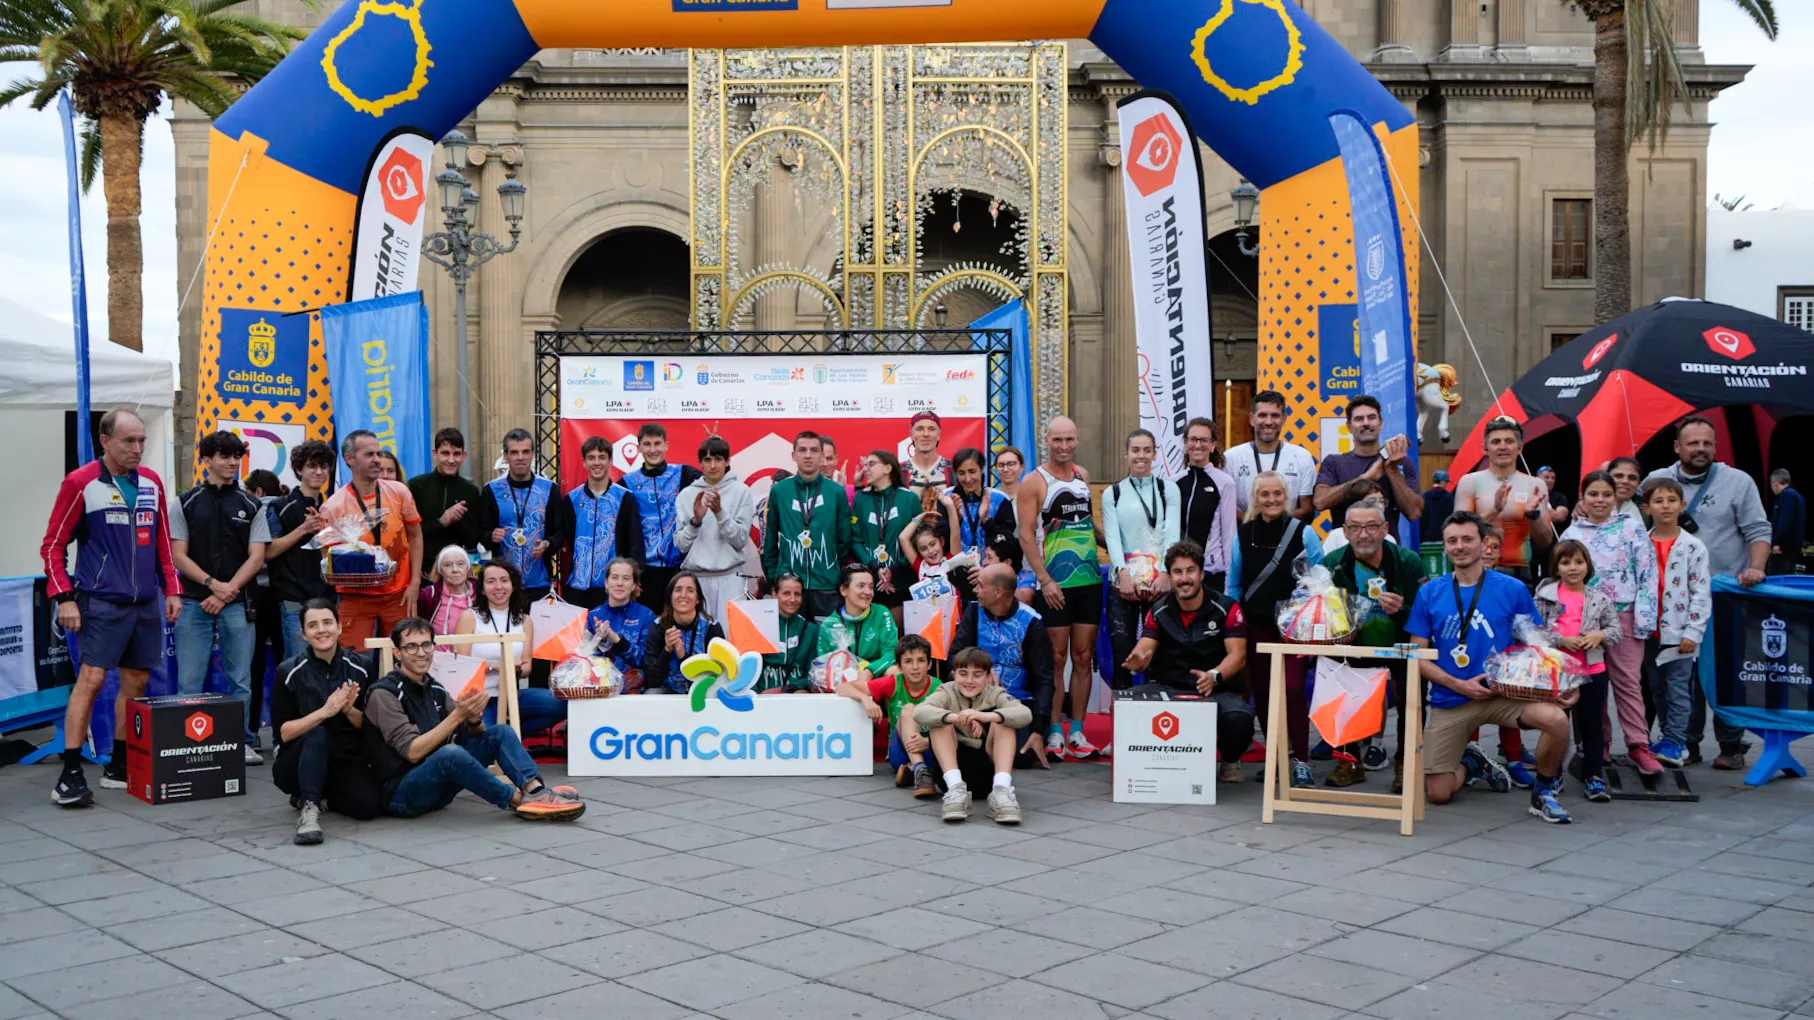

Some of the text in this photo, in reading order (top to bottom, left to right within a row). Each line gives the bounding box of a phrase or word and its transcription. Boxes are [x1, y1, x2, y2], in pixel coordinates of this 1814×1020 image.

[228, 369, 293, 385] Cabildo de
[1332, 366, 1361, 377] Cabi
[223, 381, 301, 396] Gran Canaria
[567, 378, 612, 386] GranCanaria
[1326, 378, 1358, 389] Gran
[1743, 661, 1804, 674] Cabildo de
[1738, 670, 1812, 684] Gran Canaria
[590, 725, 852, 760] GranCanaria
